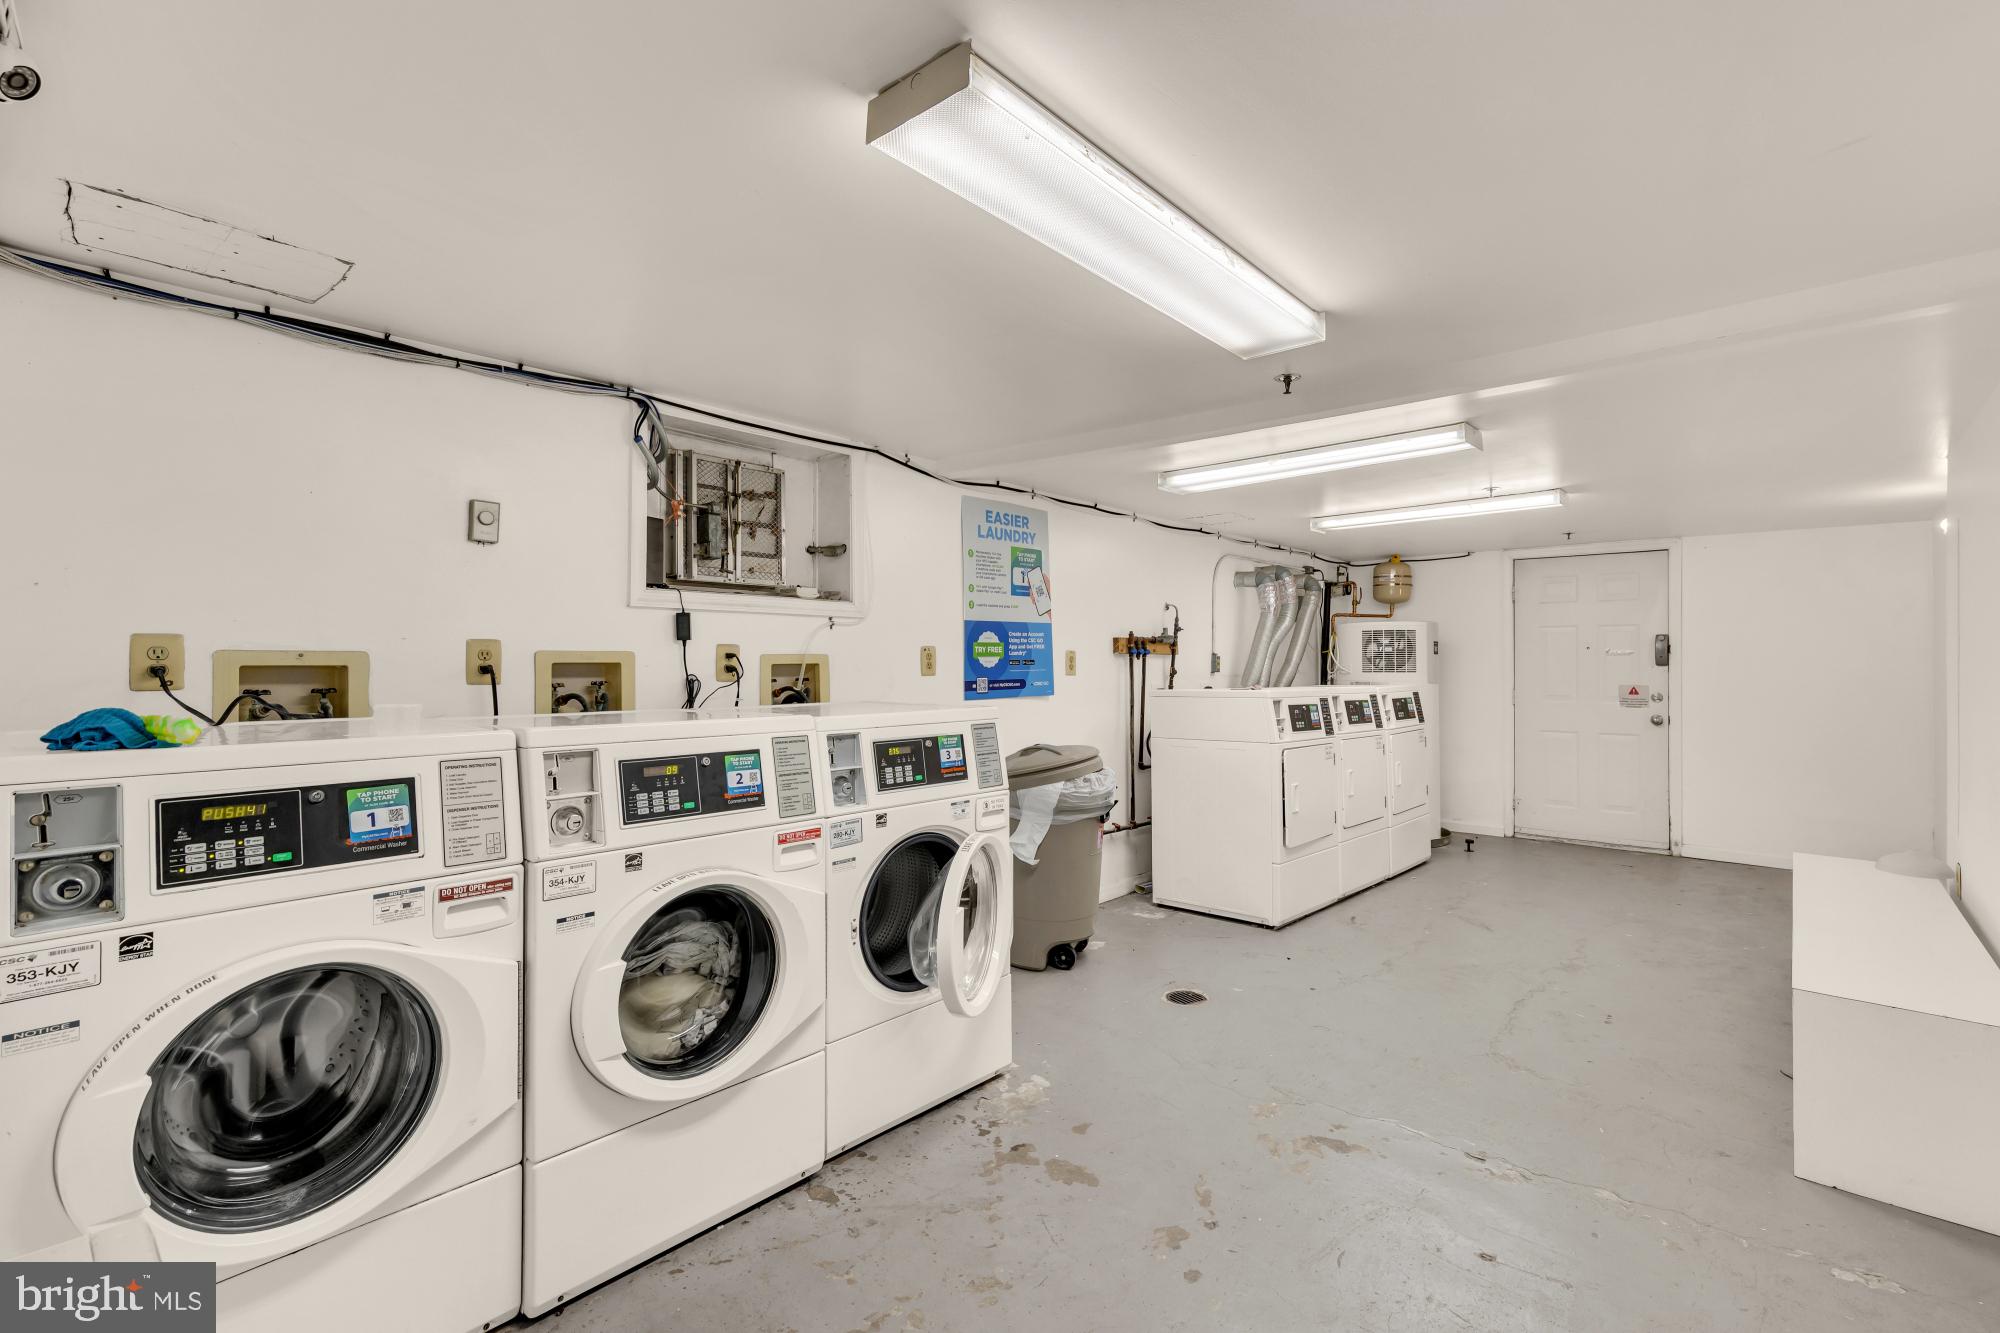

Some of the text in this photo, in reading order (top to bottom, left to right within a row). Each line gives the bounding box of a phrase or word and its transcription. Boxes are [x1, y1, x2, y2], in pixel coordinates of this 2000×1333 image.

[985, 510, 1030, 529] EASIER
[977, 524, 1036, 544] LAUNDRY
[945, 750, 951, 760] 3
[736, 772, 744, 785] 2
[373, 788, 399, 796] PHONE
[373, 794, 397, 802] START
[366, 812, 376, 828] 1
[352, 843, 386, 853] Commercial
[387, 840, 408, 849] Washer
[548, 874, 586, 888] 354-KJY
[453, 886, 468, 894] NOT
[468, 883, 487, 891] OPEN
[0, 956, 26, 966] CSC
[118, 953, 138, 962] ENERGY
[6, 961, 80, 984] 353-KJY
[13, 1022, 71, 1040] NOTICE
[80, 1055, 109, 1092] LEAVE
[111, 1023, 141, 1052] OPEN
[145, 994, 182, 1022] WHEN
[185, 974, 218, 995] DONE
